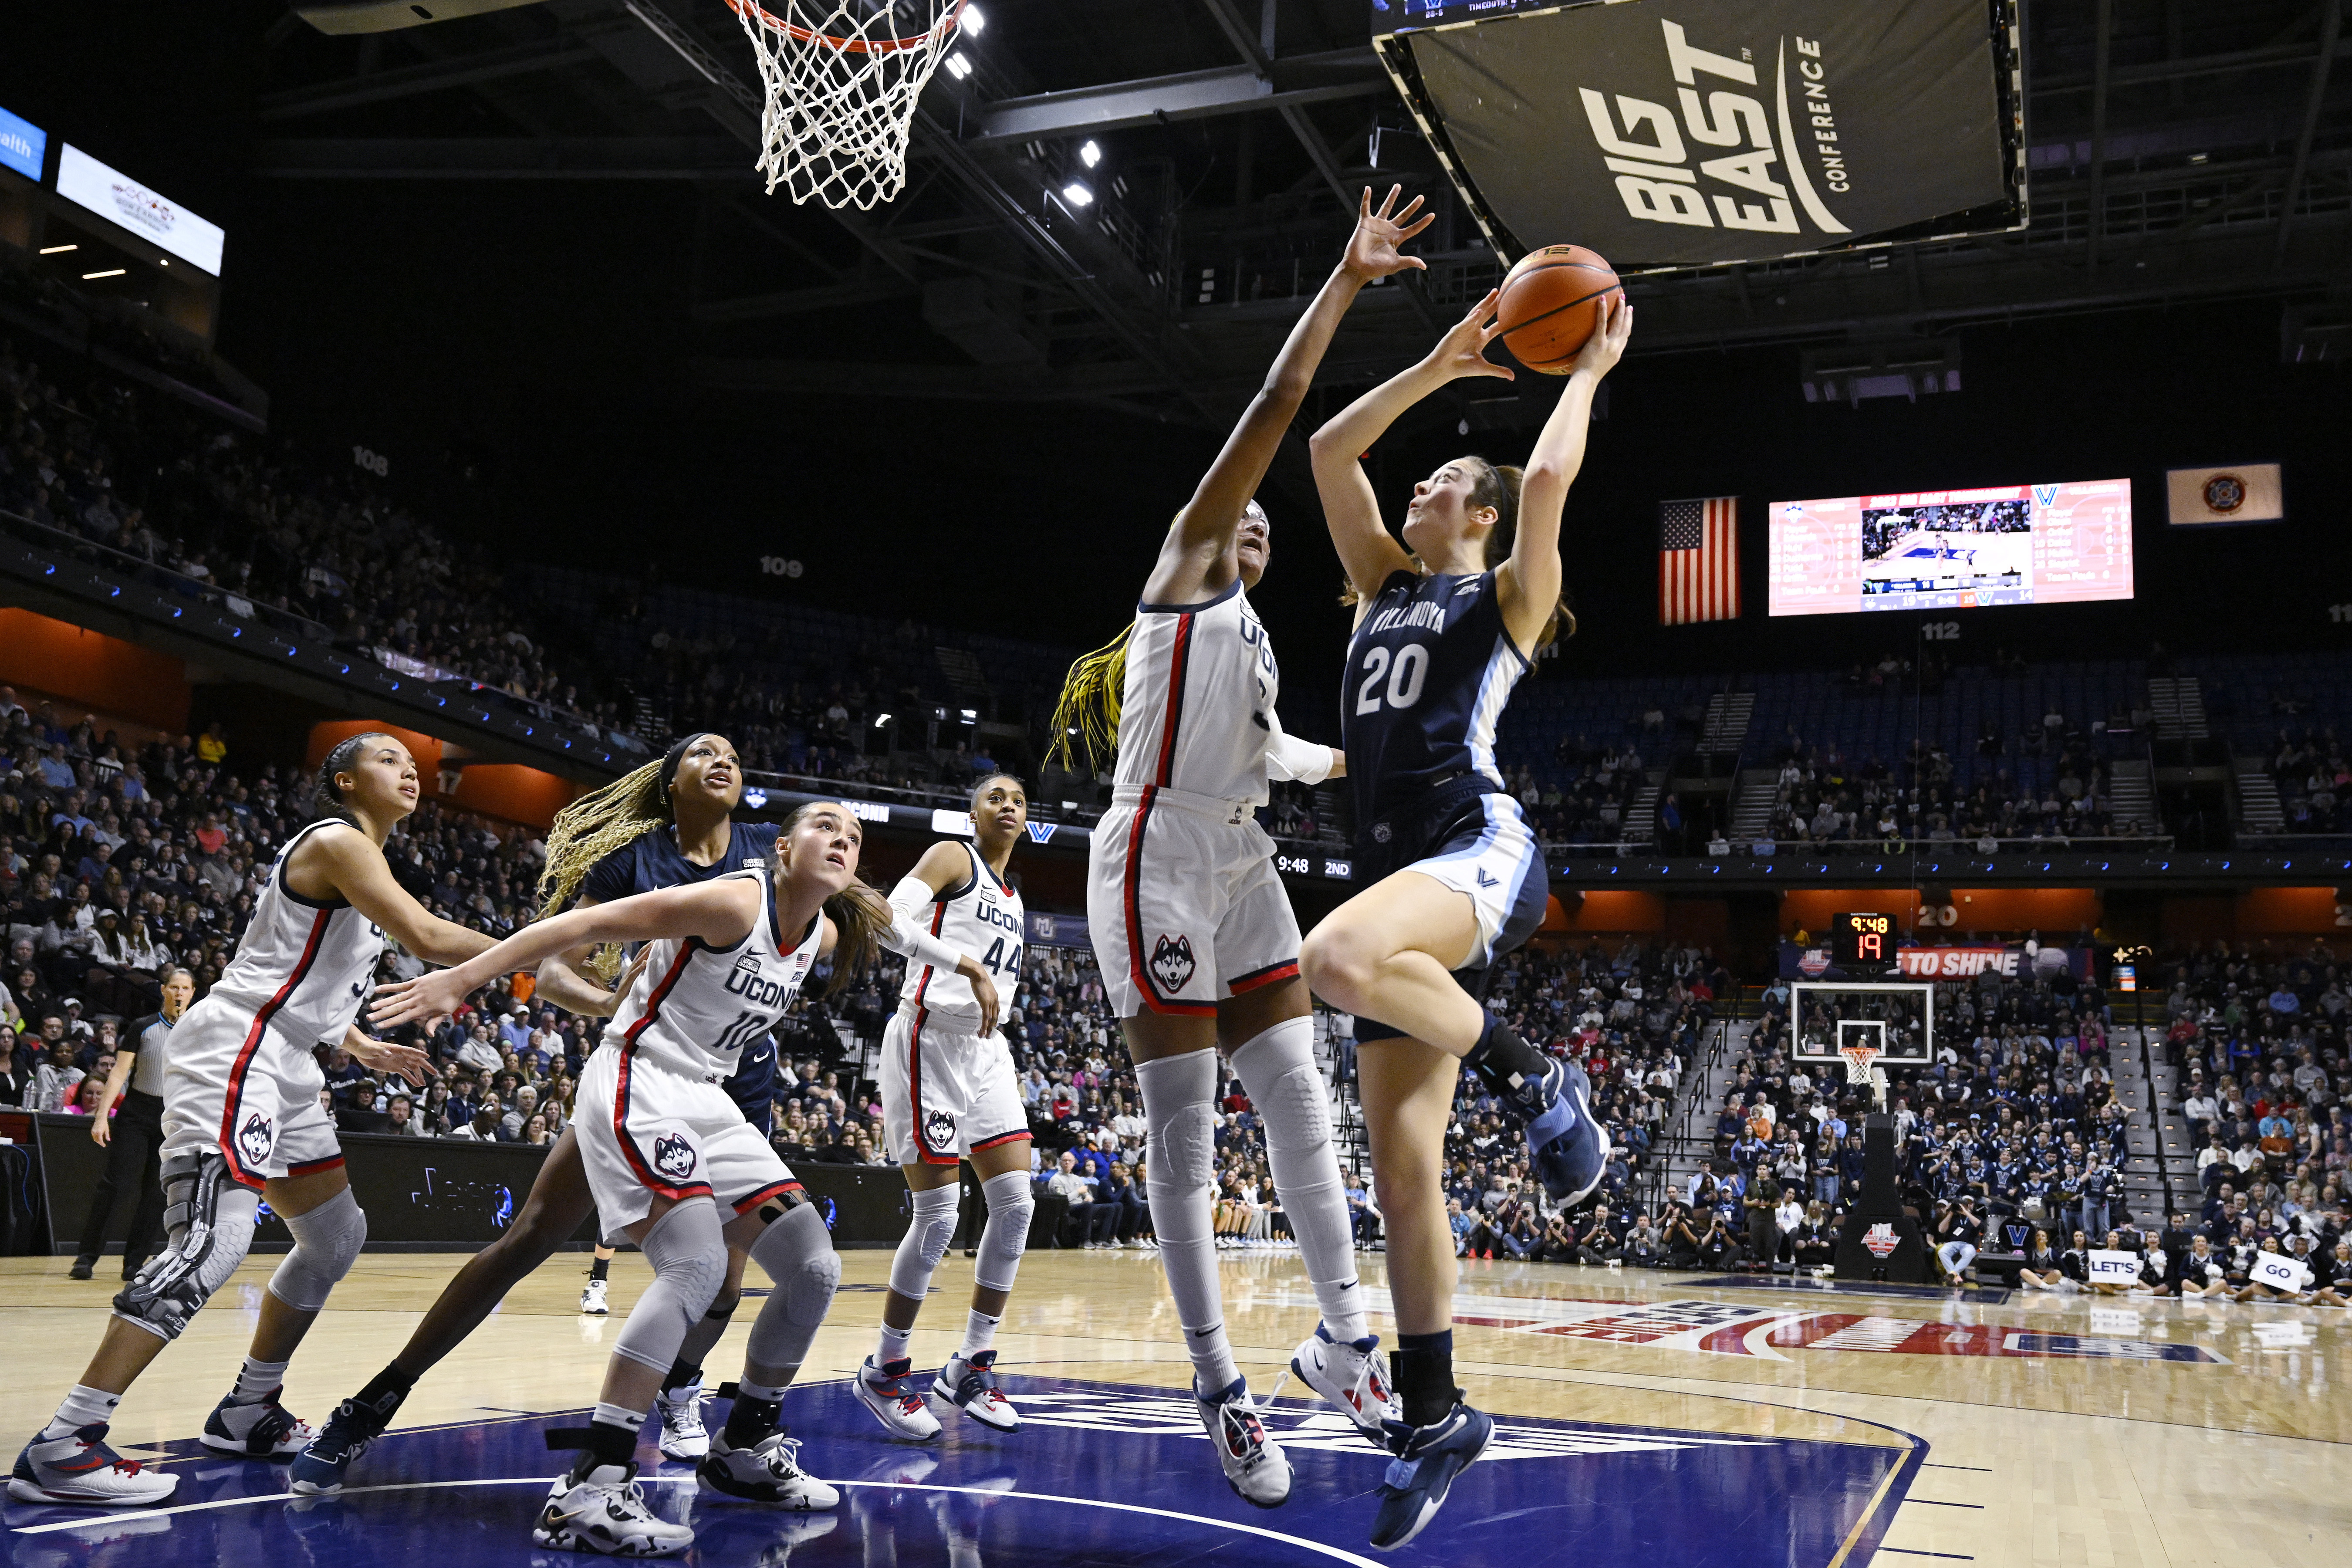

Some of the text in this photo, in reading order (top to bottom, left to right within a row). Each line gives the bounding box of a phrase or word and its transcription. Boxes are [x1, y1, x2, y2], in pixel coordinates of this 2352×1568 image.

[1660, 18, 1801, 233] EAST
[1796, 36, 1851, 193] CONFERENCE
[1579, 87, 1714, 228] BIG
[353, 445, 389, 477] 108
[760, 556, 804, 578] 109
[1903, 595, 1916, 606] 19
[1937, 595, 1957, 605] 9:48
[1964, 595, 1974, 604] 19
[2019, 589, 2033, 601] 14
[1922, 622, 1960, 640] 112
[1356, 643, 1429, 716] 20
[1278, 856, 1349, 876] 9:48 2ND
[976, 901, 1024, 940] UCON
[1851, 917, 1888, 933] 9:48
[1918, 905, 1958, 927] 20
[1859, 934, 1881, 959] 19
[983, 936, 1021, 983] 44
[1908, 953, 1939, 976] TO
[1942, 953, 2020, 976] SHINE
[711, 1011, 768, 1051] 10
[196, 1178, 204, 1203] TITANIUM
[2092, 1260, 2134, 1274] LET'S
[2266, 1264, 2291, 1278] GO
